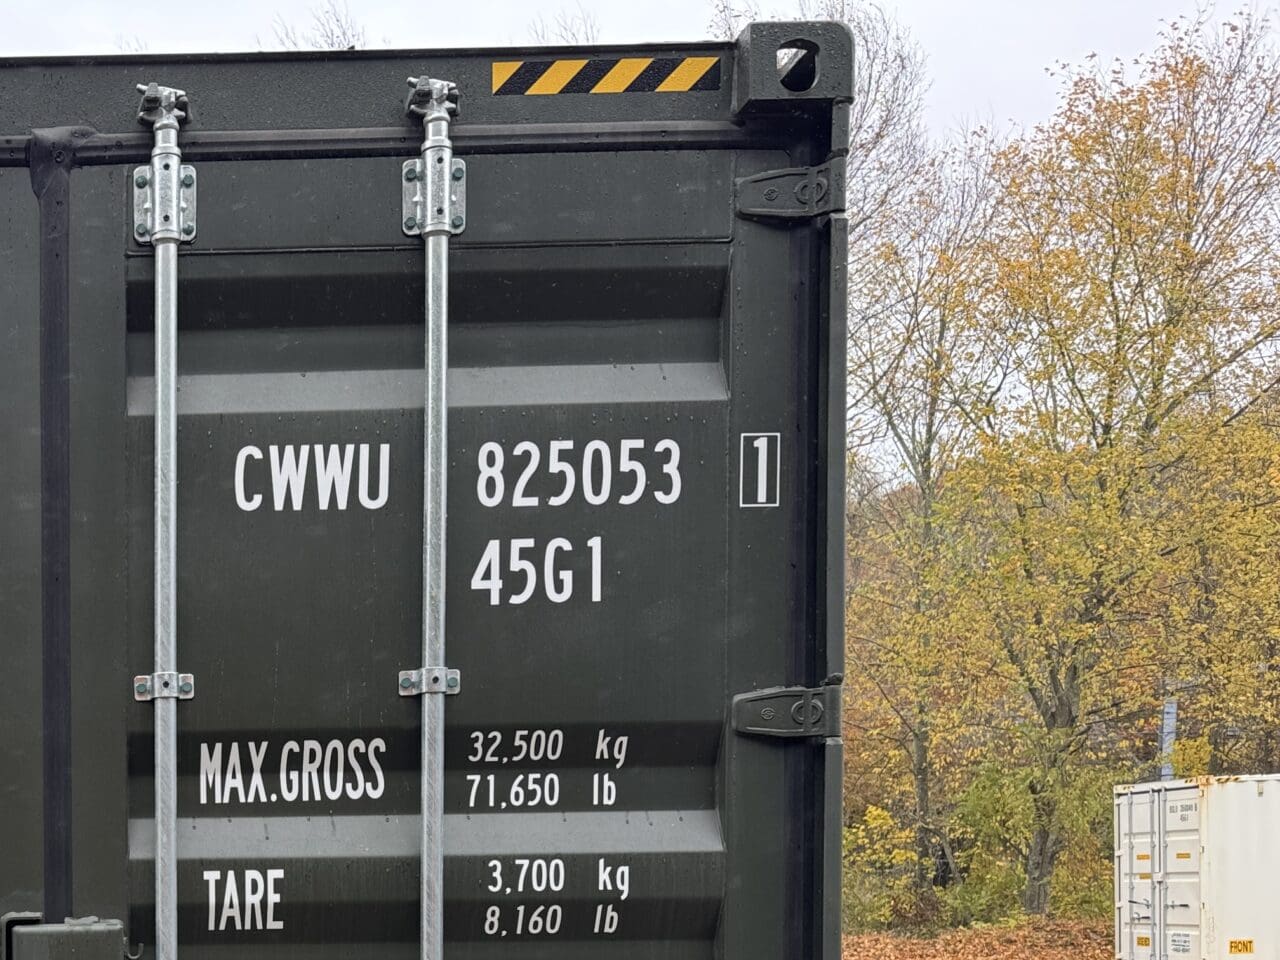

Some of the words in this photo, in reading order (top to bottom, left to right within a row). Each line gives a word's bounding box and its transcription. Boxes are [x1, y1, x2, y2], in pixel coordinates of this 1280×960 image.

[234, 443, 390, 512] CWWU
[477, 438, 682, 507] 825053
[753, 436, 768, 503] 1
[471, 536, 602, 606] 45G1
[199, 737, 387, 804] MAX.GROSS
[468, 729, 563, 764] 32,500
[595, 729, 629, 770] kg
[466, 773, 560, 809] 71,650
[593, 772, 617, 806] lb
[203, 868, 285, 931] TARE
[487, 858, 566, 895] 3,700
[598, 858, 630, 901] kg
[484, 904, 563, 937] 8,160
[593, 904, 619, 934] lb
[1229, 940, 1253, 954] FRONT
